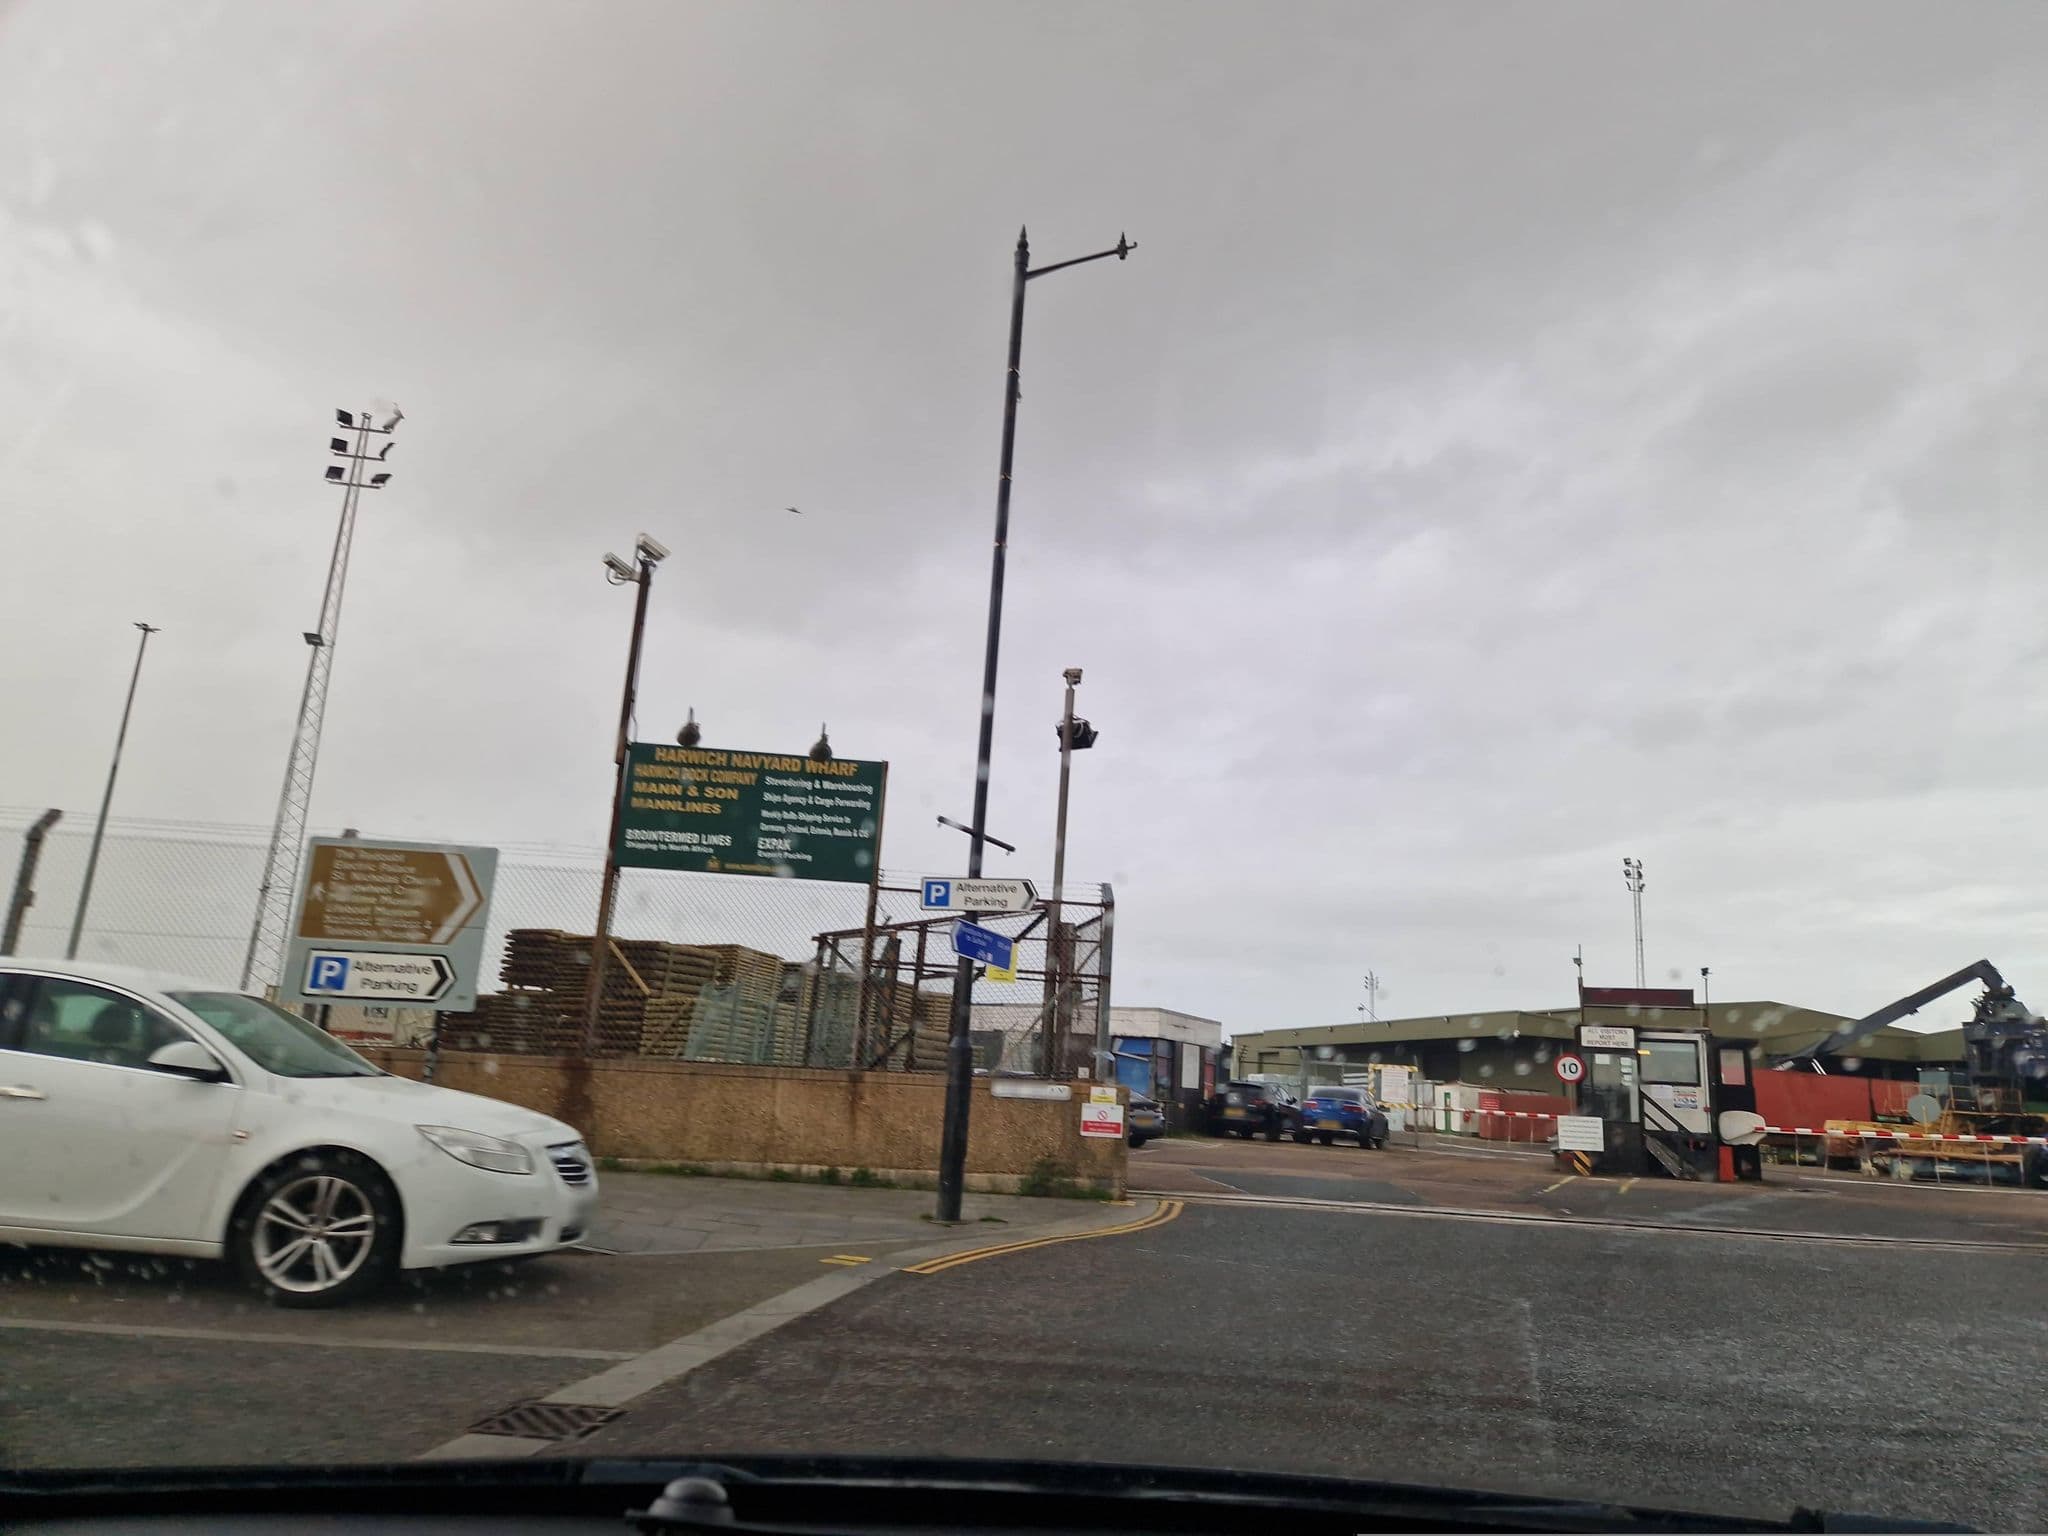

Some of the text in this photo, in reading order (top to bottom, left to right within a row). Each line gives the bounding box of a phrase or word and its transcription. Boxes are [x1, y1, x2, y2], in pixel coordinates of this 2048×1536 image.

[655, 747, 859, 777] HARWICH NAVYARD WHARF
[710, 769, 758, 786] COMPANY
[633, 780, 739, 801] MANN & SON
[630, 796, 722, 815] MANNLINES
[701, 833, 732, 847] LINES
[930, 882, 1018, 904] P Alternative
[964, 896, 1009, 909] Parking
[318, 960, 432, 986] P Alternative
[360, 977, 419, 994] Parking
[1561, 1062, 1579, 1075] 10
